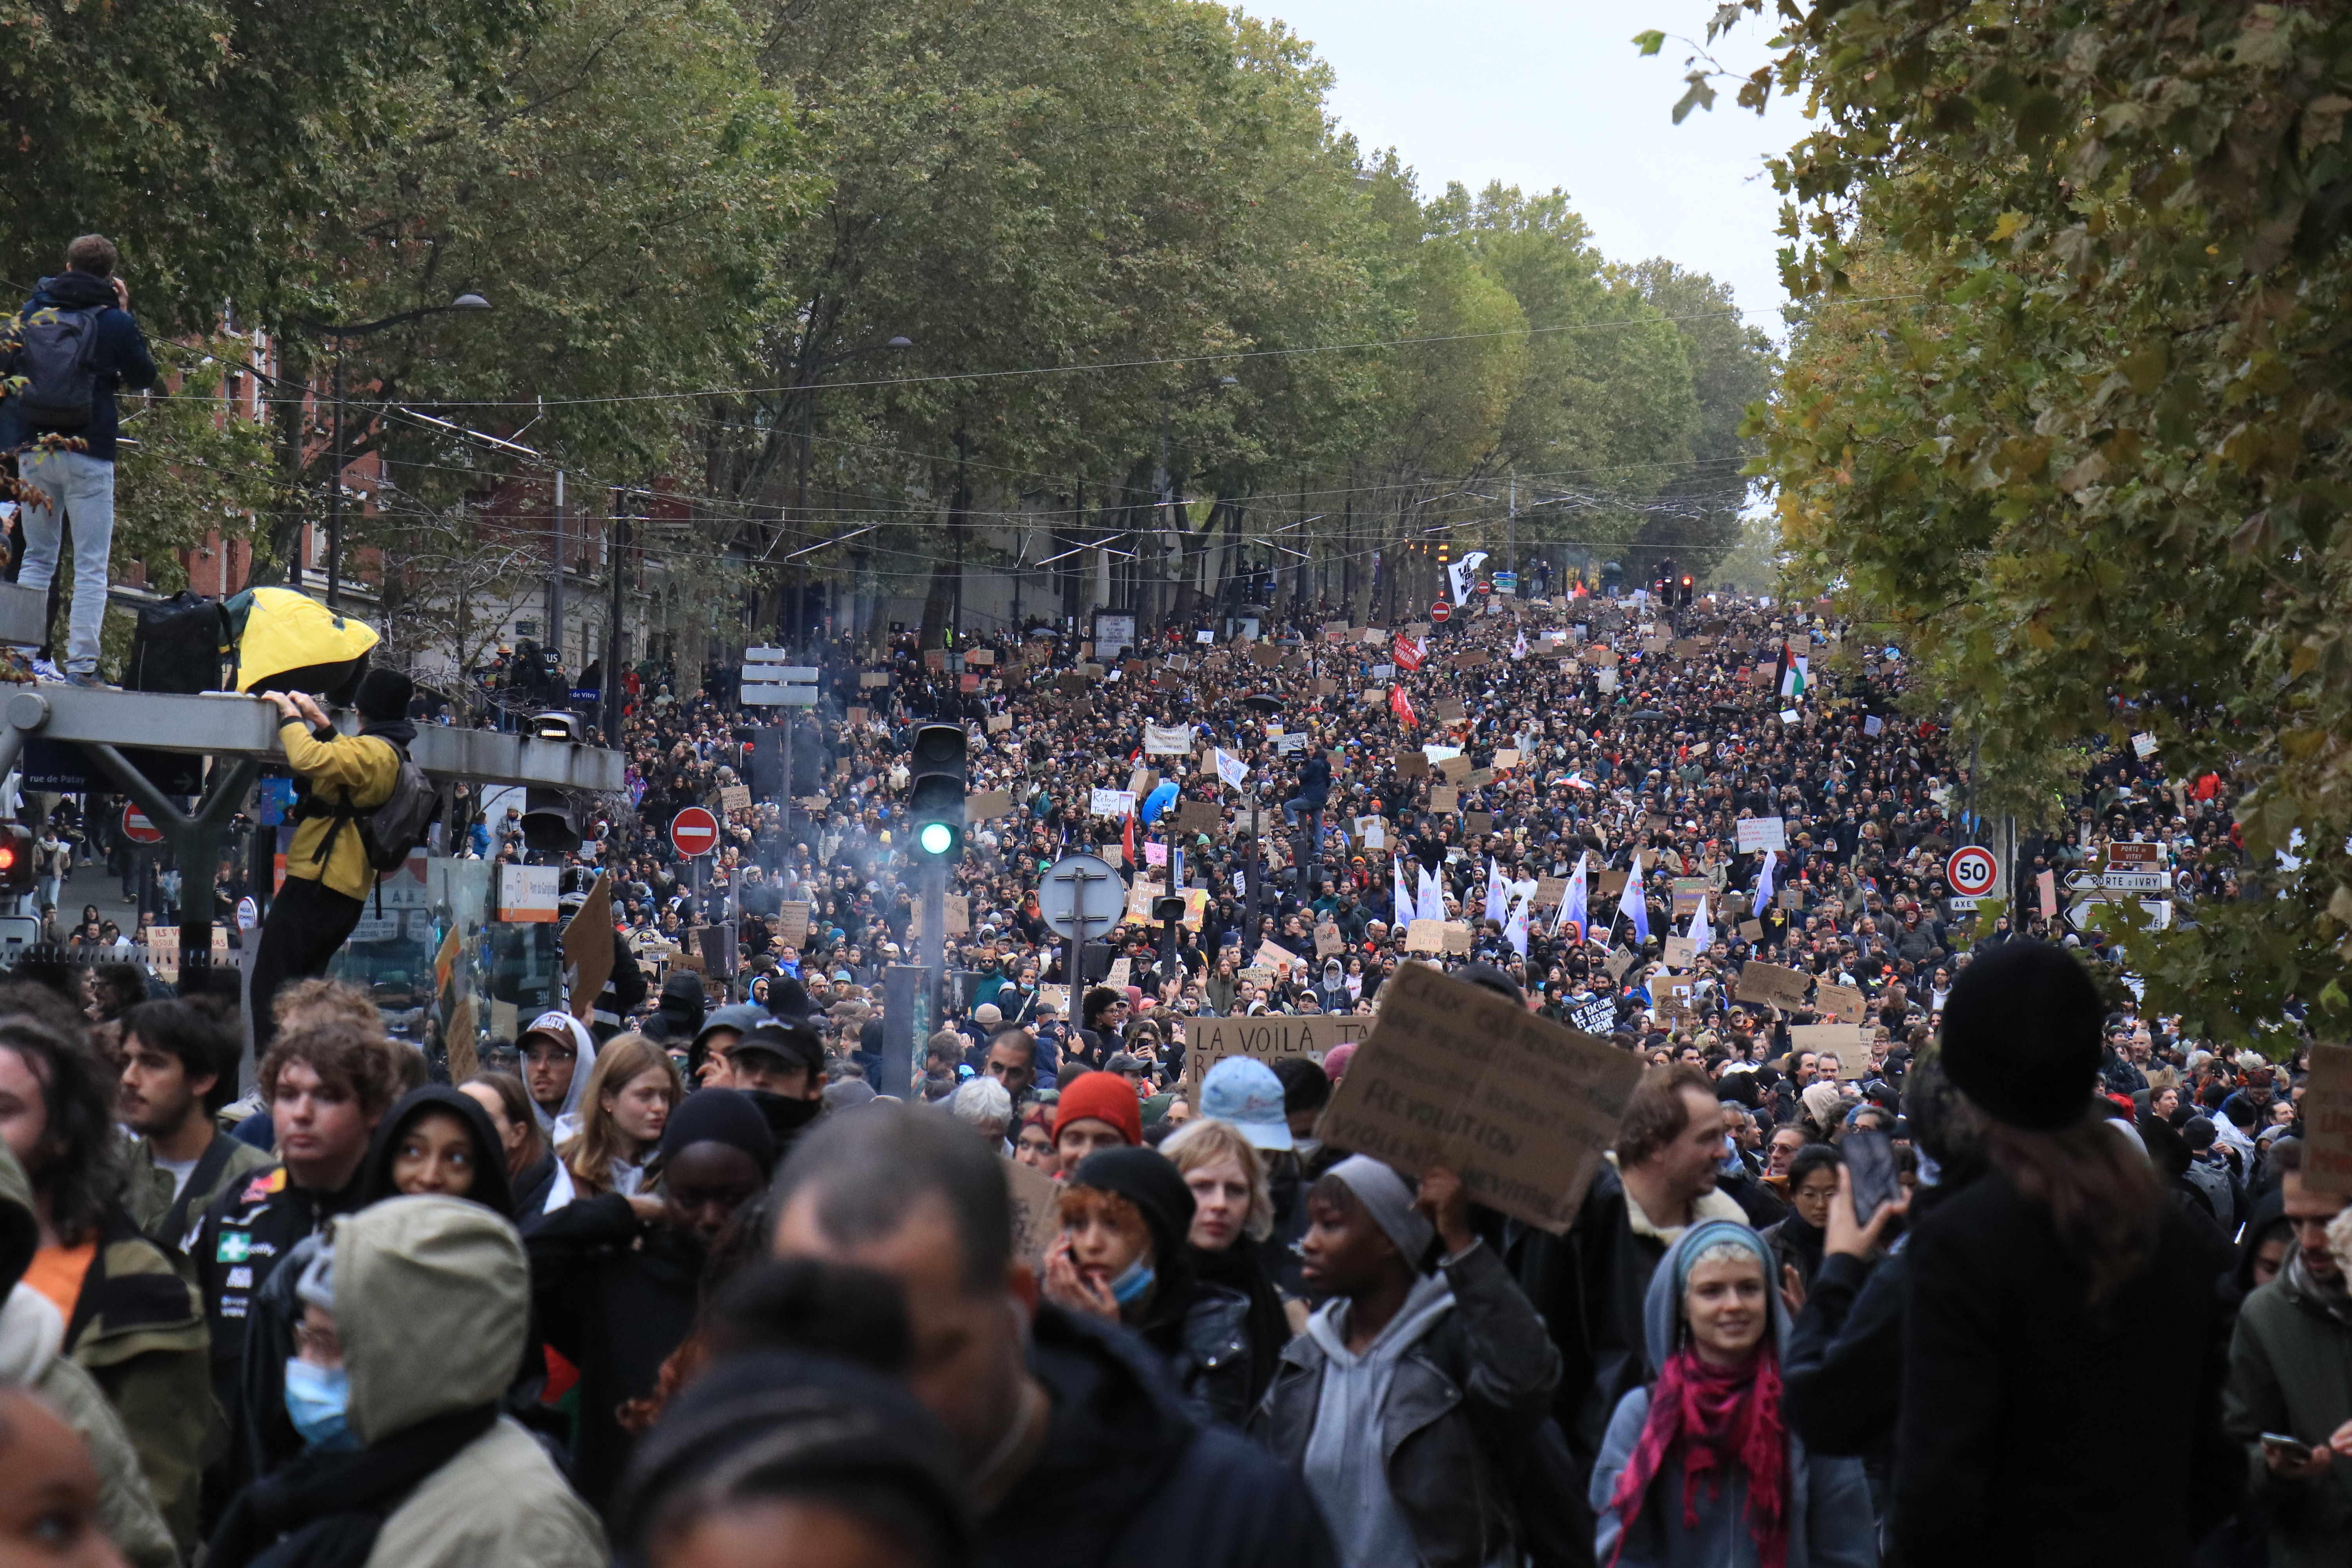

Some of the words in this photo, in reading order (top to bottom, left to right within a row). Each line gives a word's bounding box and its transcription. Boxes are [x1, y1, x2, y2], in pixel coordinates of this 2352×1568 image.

[60, 775, 85, 785] Patay
[1093, 791, 1118, 803] Retour
[1959, 862, 1986, 881] 50
[1137, 881, 1150, 892] Tout
[2092, 877, 2123, 886] PORTE
[1138, 892, 1147, 902] Le
[1182, 915, 1199, 924] quise
[155, 929, 167, 937] ILS
[1321, 933, 1333, 941] JNR
[1570, 1009, 1584, 1024] LE
[1576, 1018, 1586, 1029] ET
[1588, 1013, 1601, 1024] LES
[1197, 1027, 1224, 1052] LA
